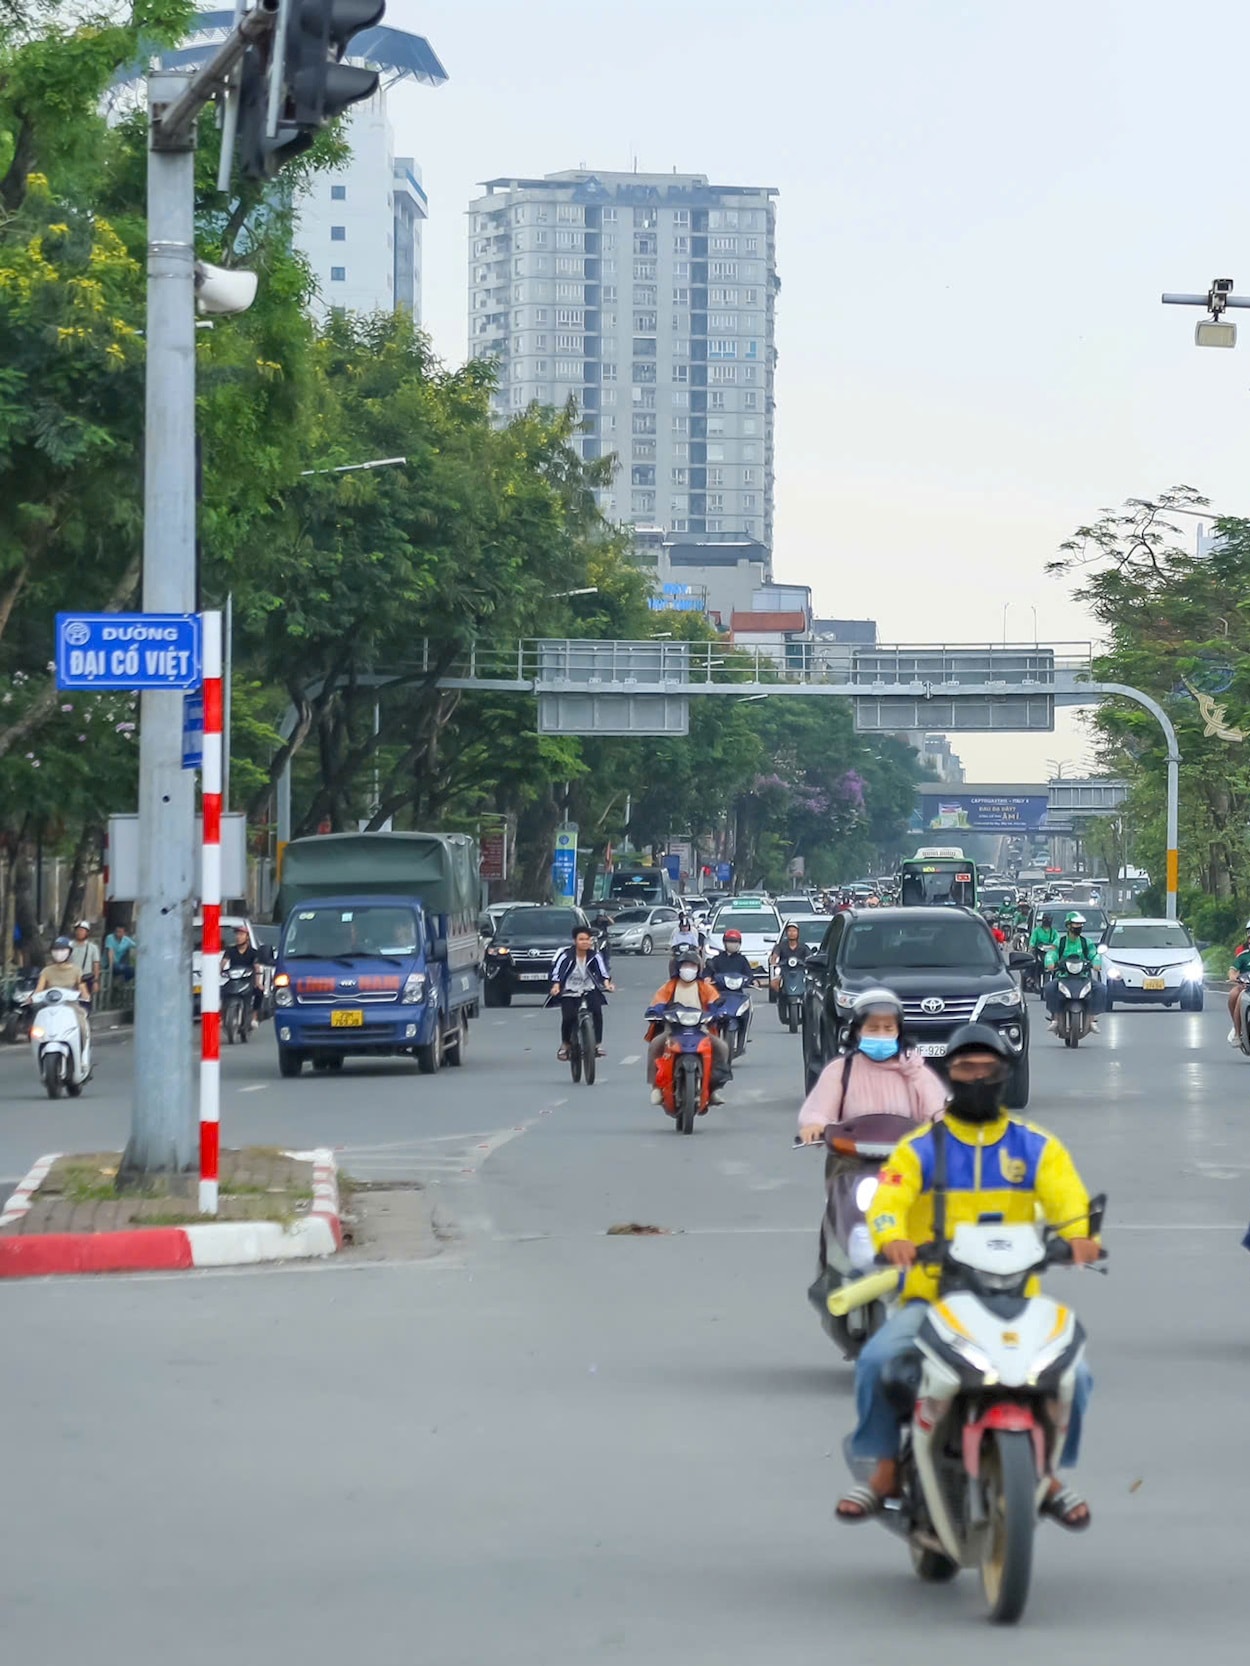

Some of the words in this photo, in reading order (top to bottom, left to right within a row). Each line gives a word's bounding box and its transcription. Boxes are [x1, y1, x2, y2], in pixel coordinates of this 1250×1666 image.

[70, 651, 106, 680] ĐẠI
[145, 645, 190, 681] VIỆT
[915, 1045, 946, 1056] F-926
